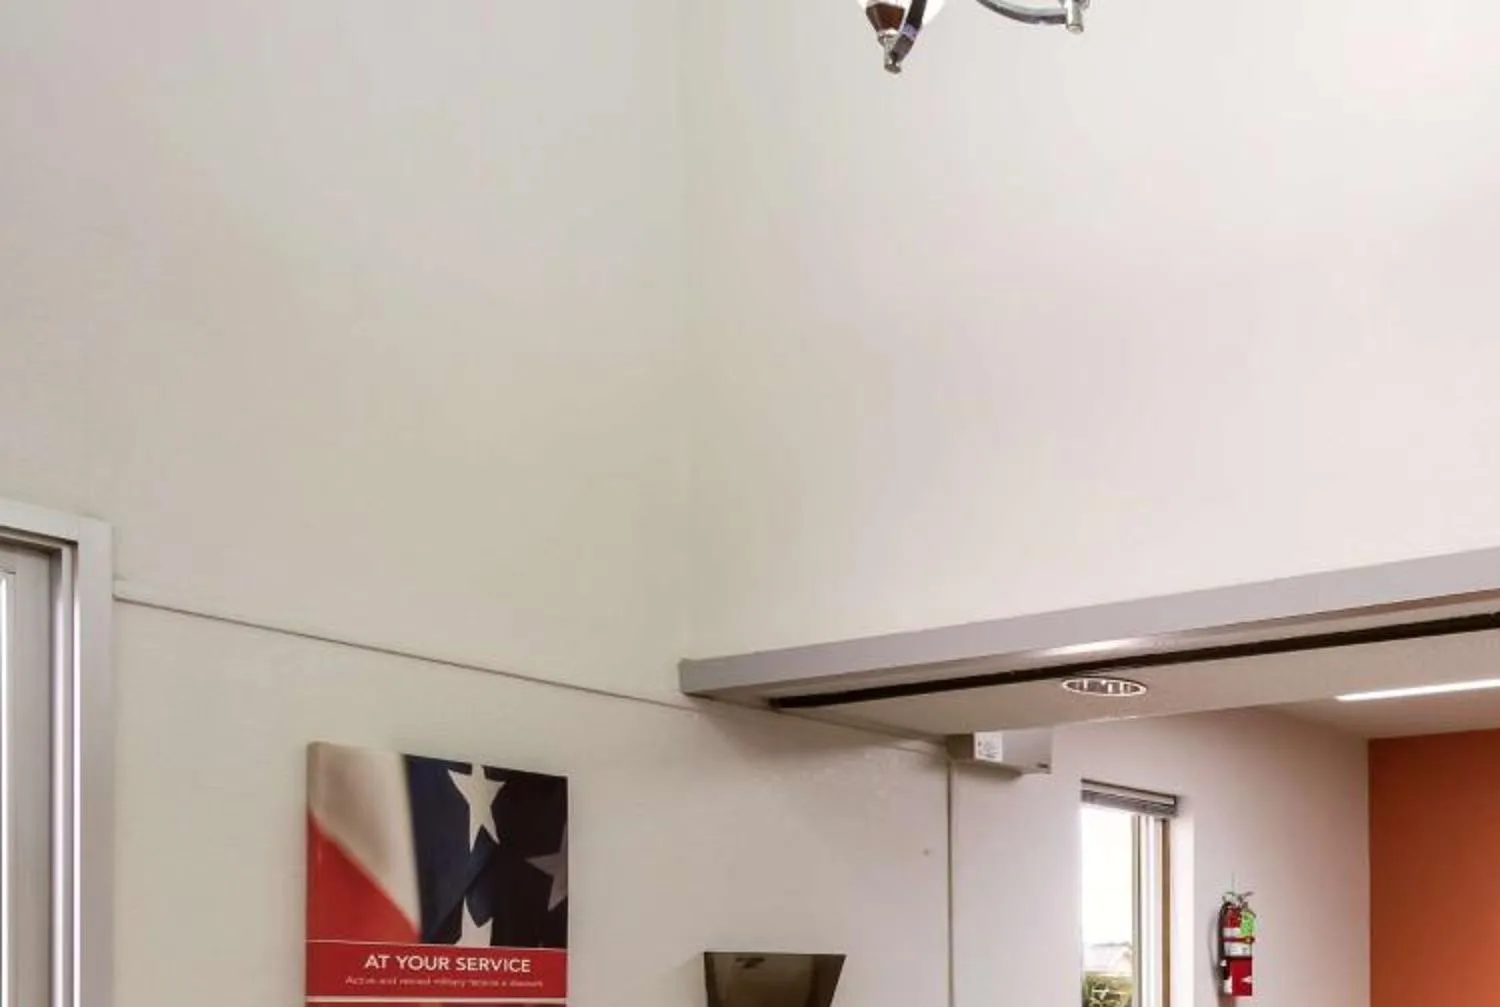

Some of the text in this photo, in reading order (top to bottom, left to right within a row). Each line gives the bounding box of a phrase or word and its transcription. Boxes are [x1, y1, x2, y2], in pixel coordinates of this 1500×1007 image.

[364, 953, 531, 973] AT YOUR SERVICE
